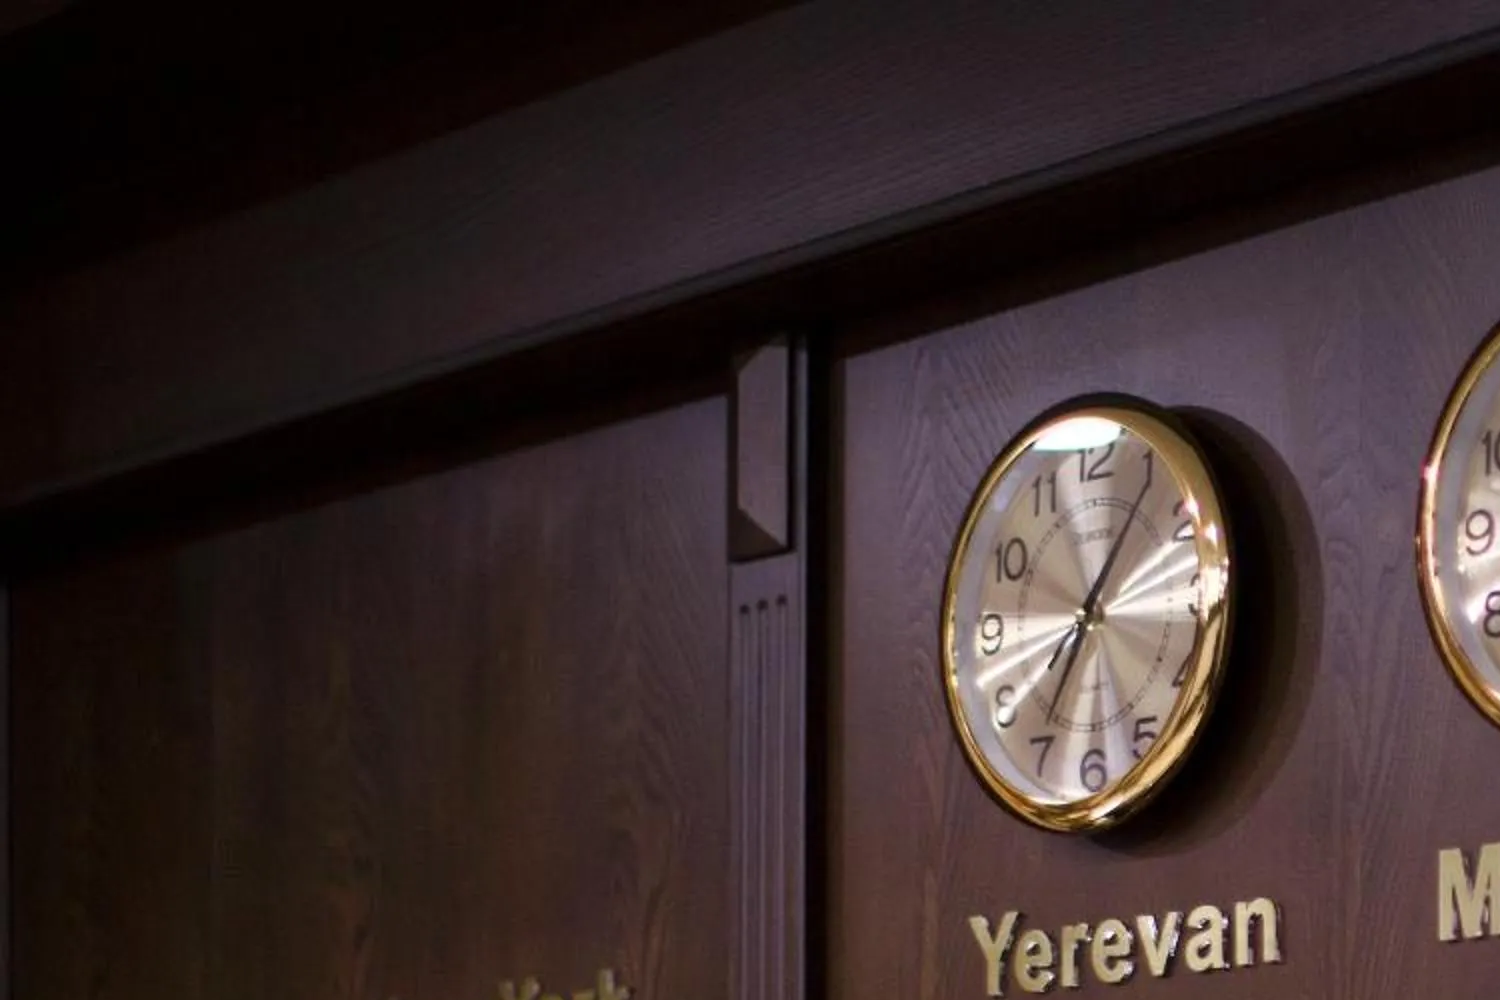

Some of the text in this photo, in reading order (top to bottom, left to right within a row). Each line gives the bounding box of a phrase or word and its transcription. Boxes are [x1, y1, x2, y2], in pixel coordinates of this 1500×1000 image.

[1076, 441, 1116, 483] 12
[1031, 469, 1057, 517] 11
[1465, 509, 1496, 555] 9
[995, 537, 1029, 583] 10
[980, 613, 1004, 655] 9
[1030, 735, 1056, 778] 7
[1132, 716, 1160, 760] 5
[1079, 748, 1108, 793] 6
[968, 895, 1283, 996] Yerevan
